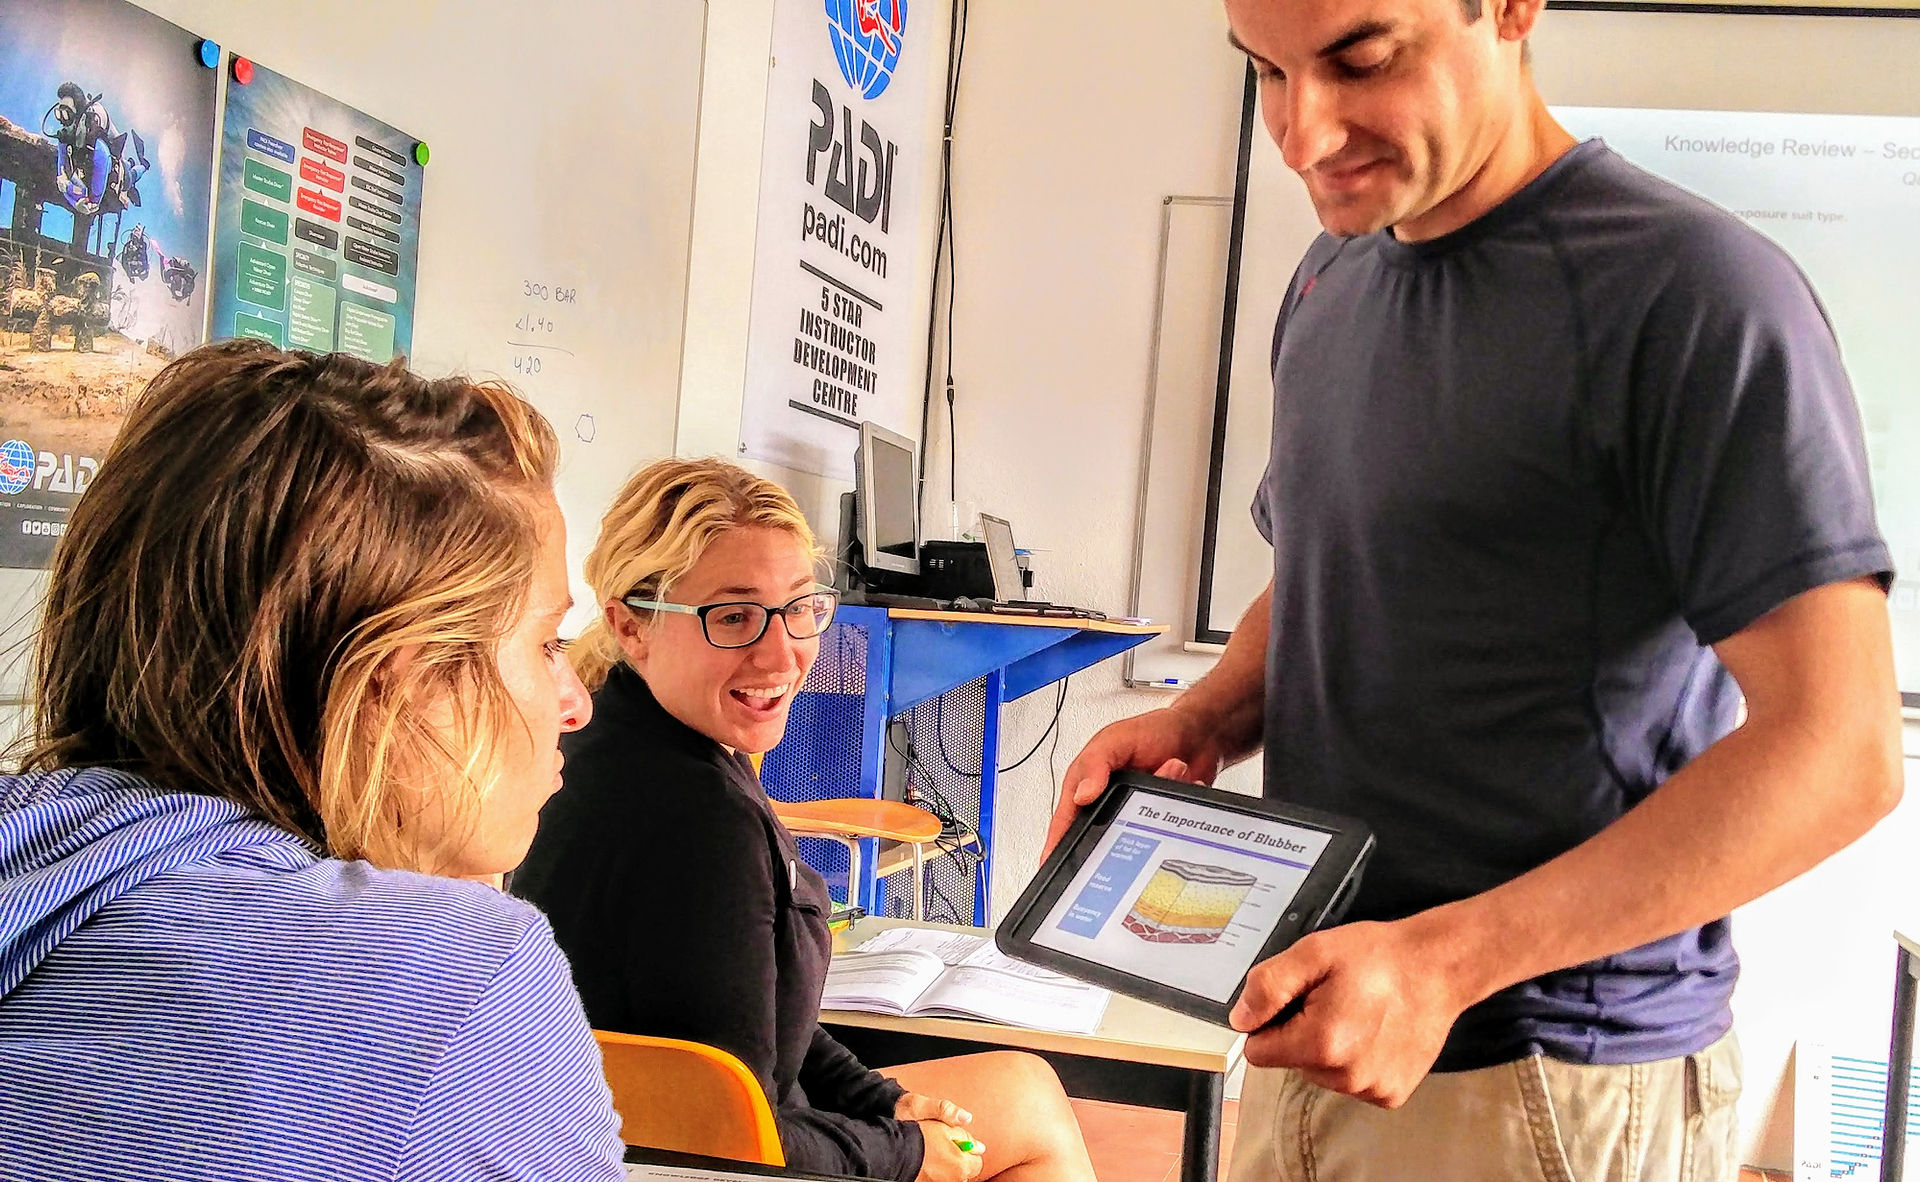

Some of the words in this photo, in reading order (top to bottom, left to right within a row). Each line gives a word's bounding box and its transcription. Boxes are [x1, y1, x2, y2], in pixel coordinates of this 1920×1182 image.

[806, 78, 895, 234] PADI
[1664, 135, 1775, 158] Knowledge
[1782, 138, 1856, 158] Review
[802, 202, 888, 279] padi.com
[523, 280, 549, 301] 300
[555, 287, 577, 303] BAR
[820, 286, 830, 312] 5
[832, 293, 863, 329] STAR
[799, 307, 876, 365] INSTRUCTOR
[514, 356, 542, 377] 420
[793, 337, 878, 395] DEVELOPMENT
[812, 379, 859, 417] CENTRE
[33, 451, 105, 494] PAD
[1138, 805, 1160, 820] The
[1161, 811, 1235, 837] Importance
[1237, 829, 1256, 841] of
[1253, 833, 1308, 854] Blubber
[1094, 873, 1112, 883] Food
